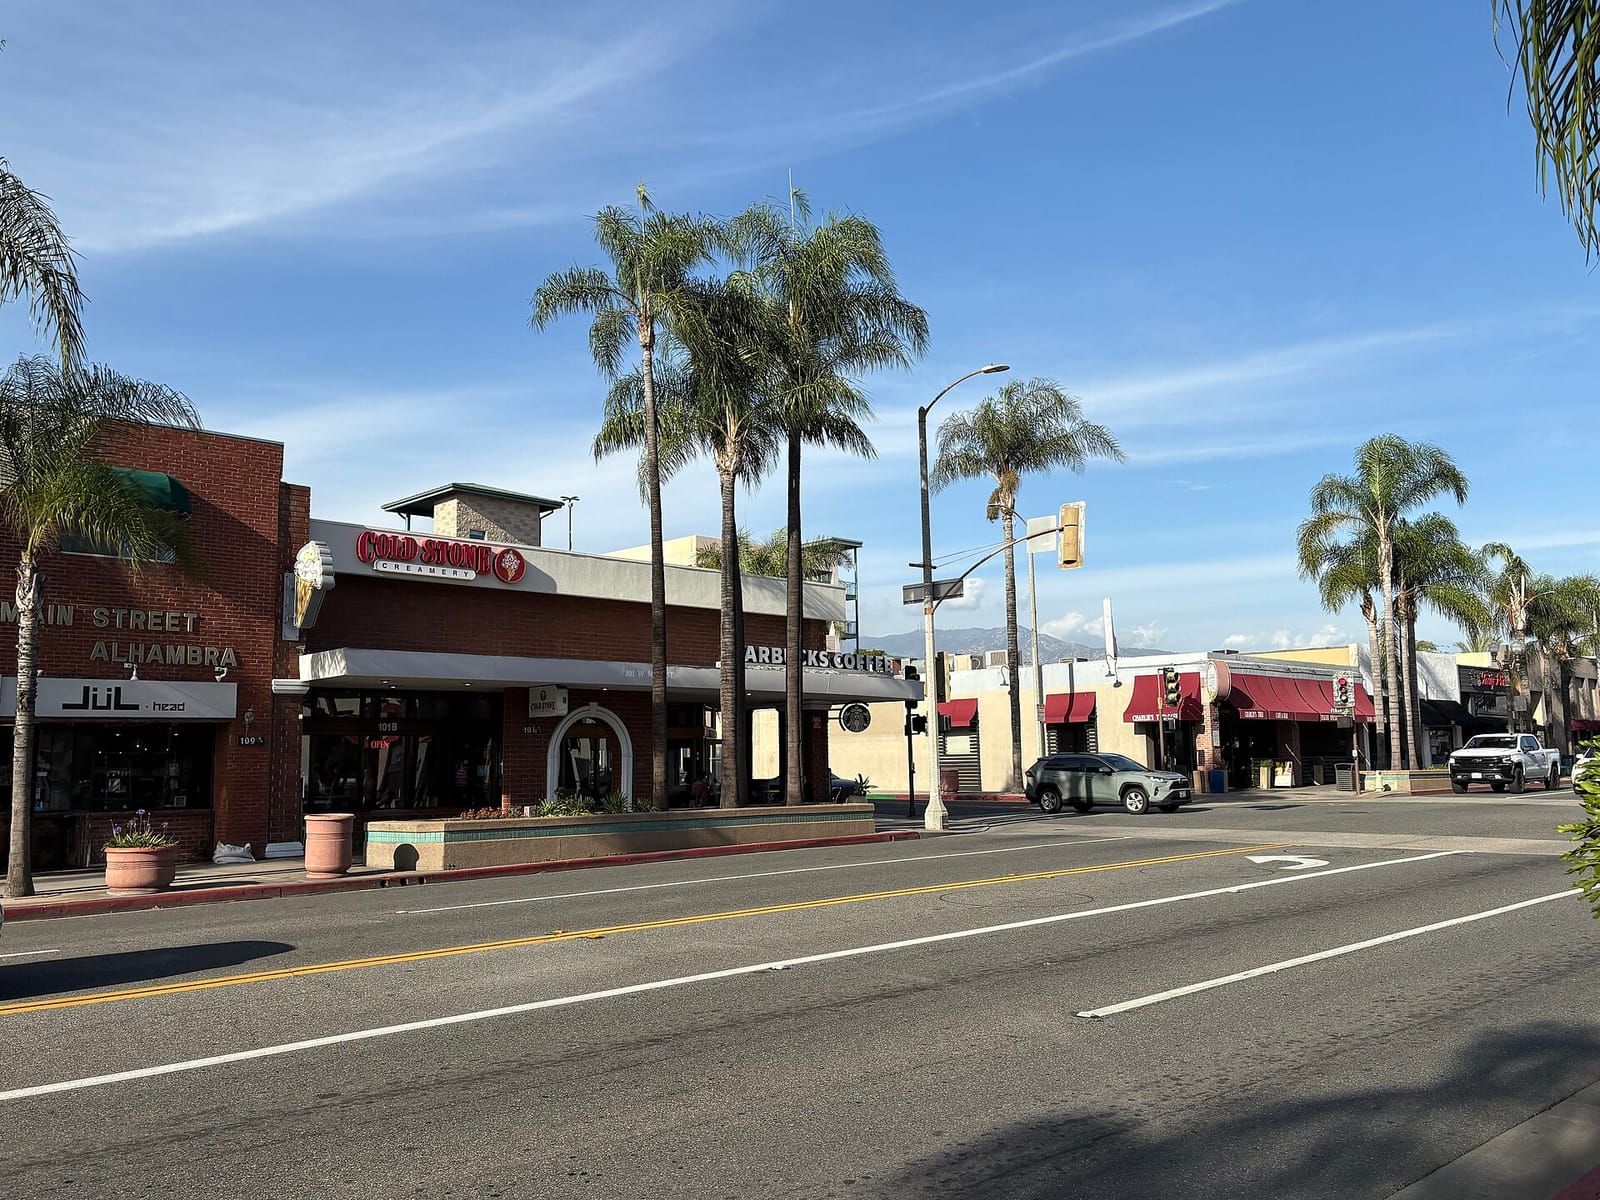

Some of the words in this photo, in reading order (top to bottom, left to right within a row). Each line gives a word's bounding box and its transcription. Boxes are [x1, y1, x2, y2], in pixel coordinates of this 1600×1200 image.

[357, 531, 418, 563] COLD
[421, 539, 493, 576] STONE
[382, 562, 470, 577] CREAMERY
[93, 607, 197, 632] STREET
[90, 641, 237, 667] ALHAMBRA
[833, 653, 894, 674] COFFEE
[153, 702, 185, 711] head
[378, 723, 398, 731] 101B
[371, 740, 390, 749] OPEN
